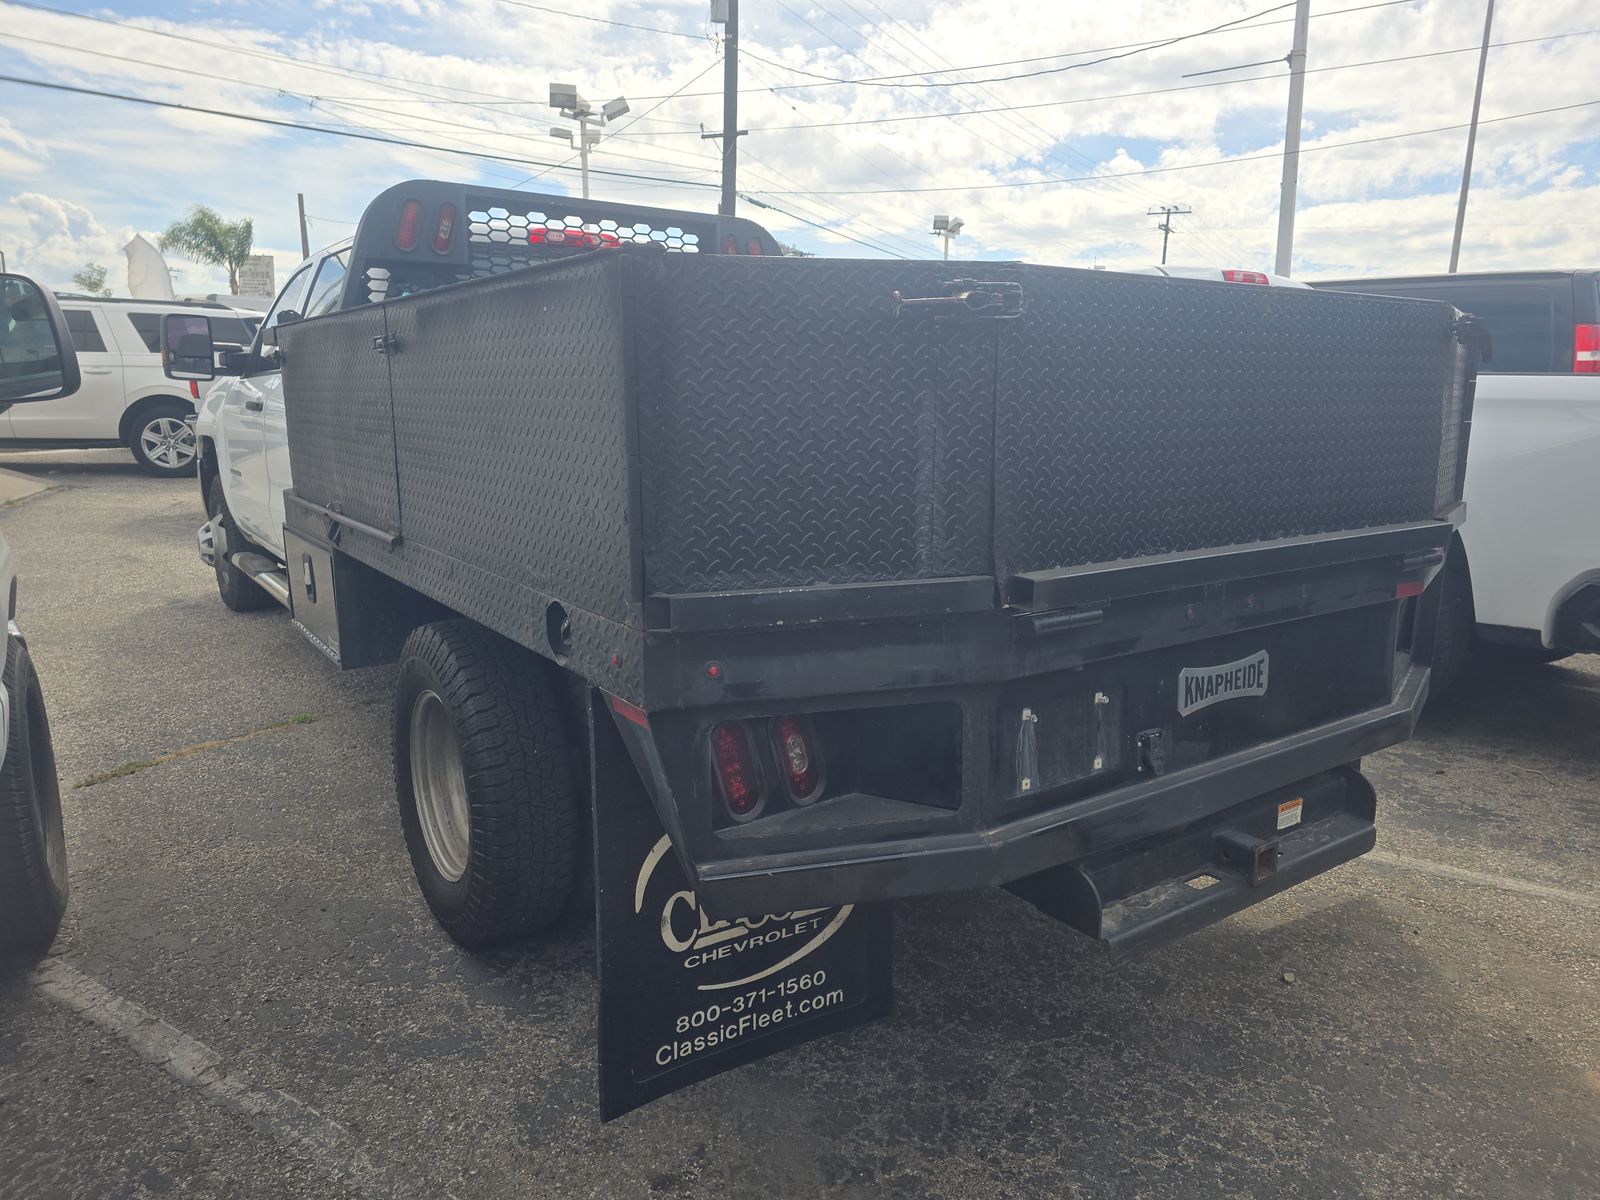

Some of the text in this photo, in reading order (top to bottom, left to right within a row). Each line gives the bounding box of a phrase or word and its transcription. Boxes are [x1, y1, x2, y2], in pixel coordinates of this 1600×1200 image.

[1184, 658, 1265, 708] KNAPHEIDE
[684, 917, 823, 968] CHEVROLET
[655, 988, 844, 1065] ClassicFleet.com
[676, 970, 826, 1033] 800-371-1560
